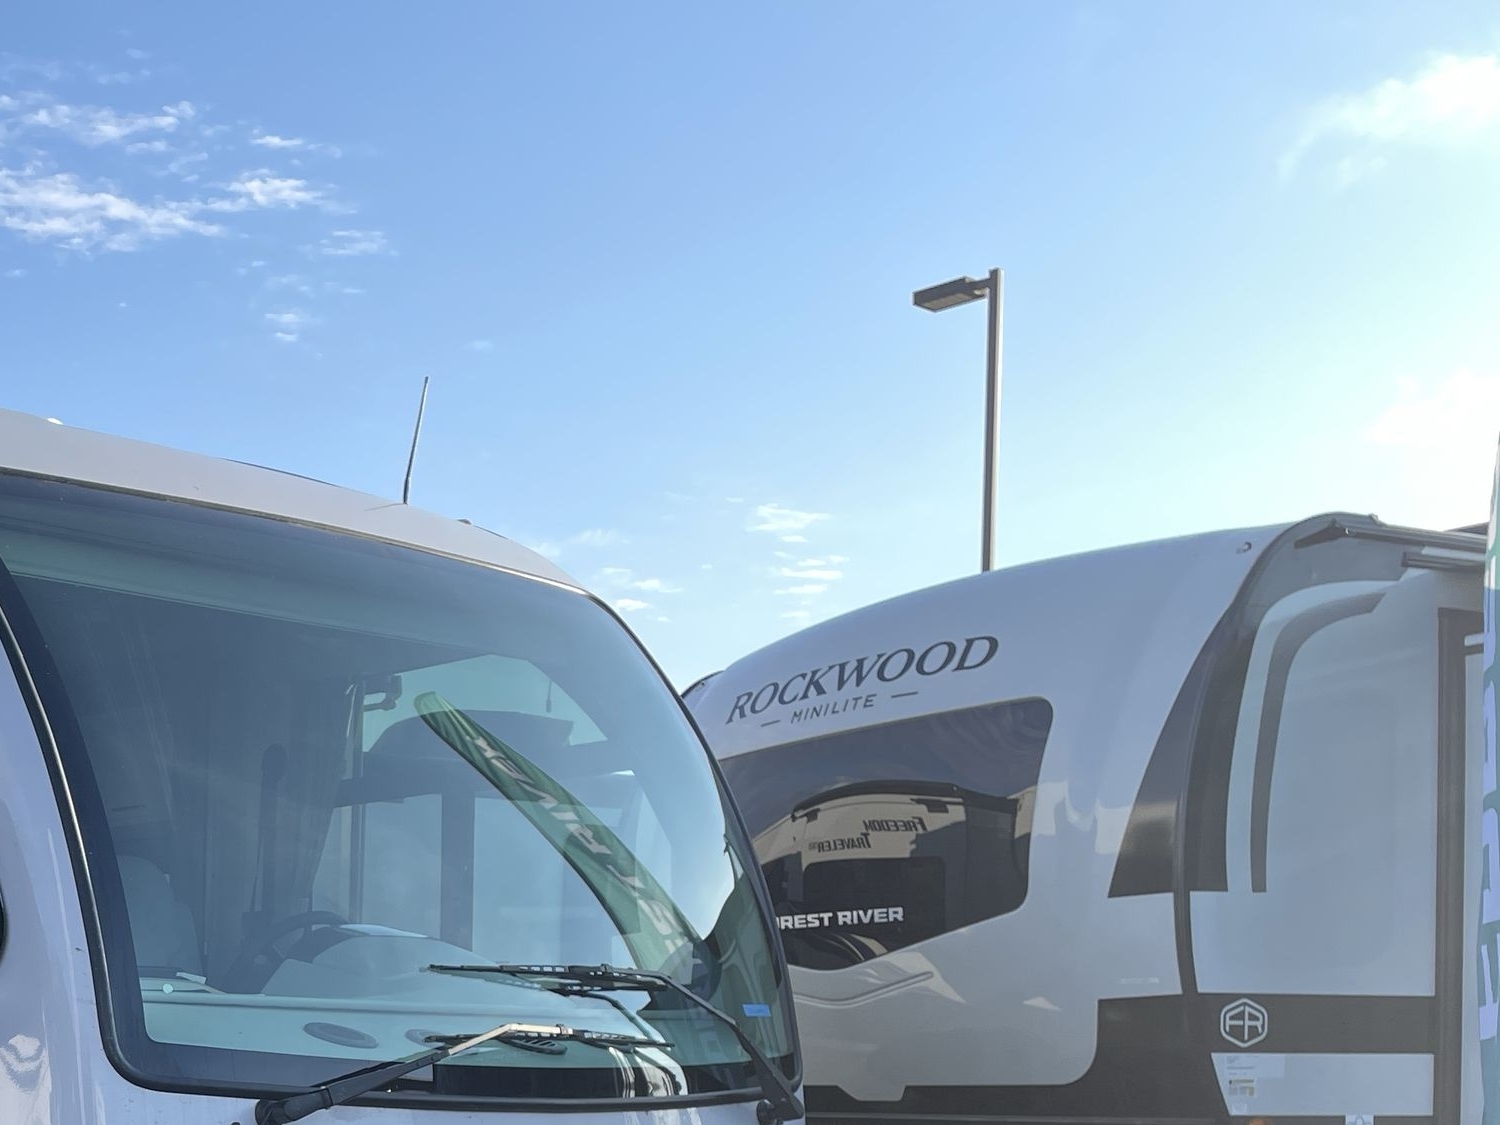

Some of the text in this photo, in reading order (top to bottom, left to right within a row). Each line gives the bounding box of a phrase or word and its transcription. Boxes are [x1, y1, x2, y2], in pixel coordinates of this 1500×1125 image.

[725, 635, 1000, 725] ROCKWOOD
[790, 694, 878, 724] MINILITE
[776, 906, 904, 930] REST RIVER
